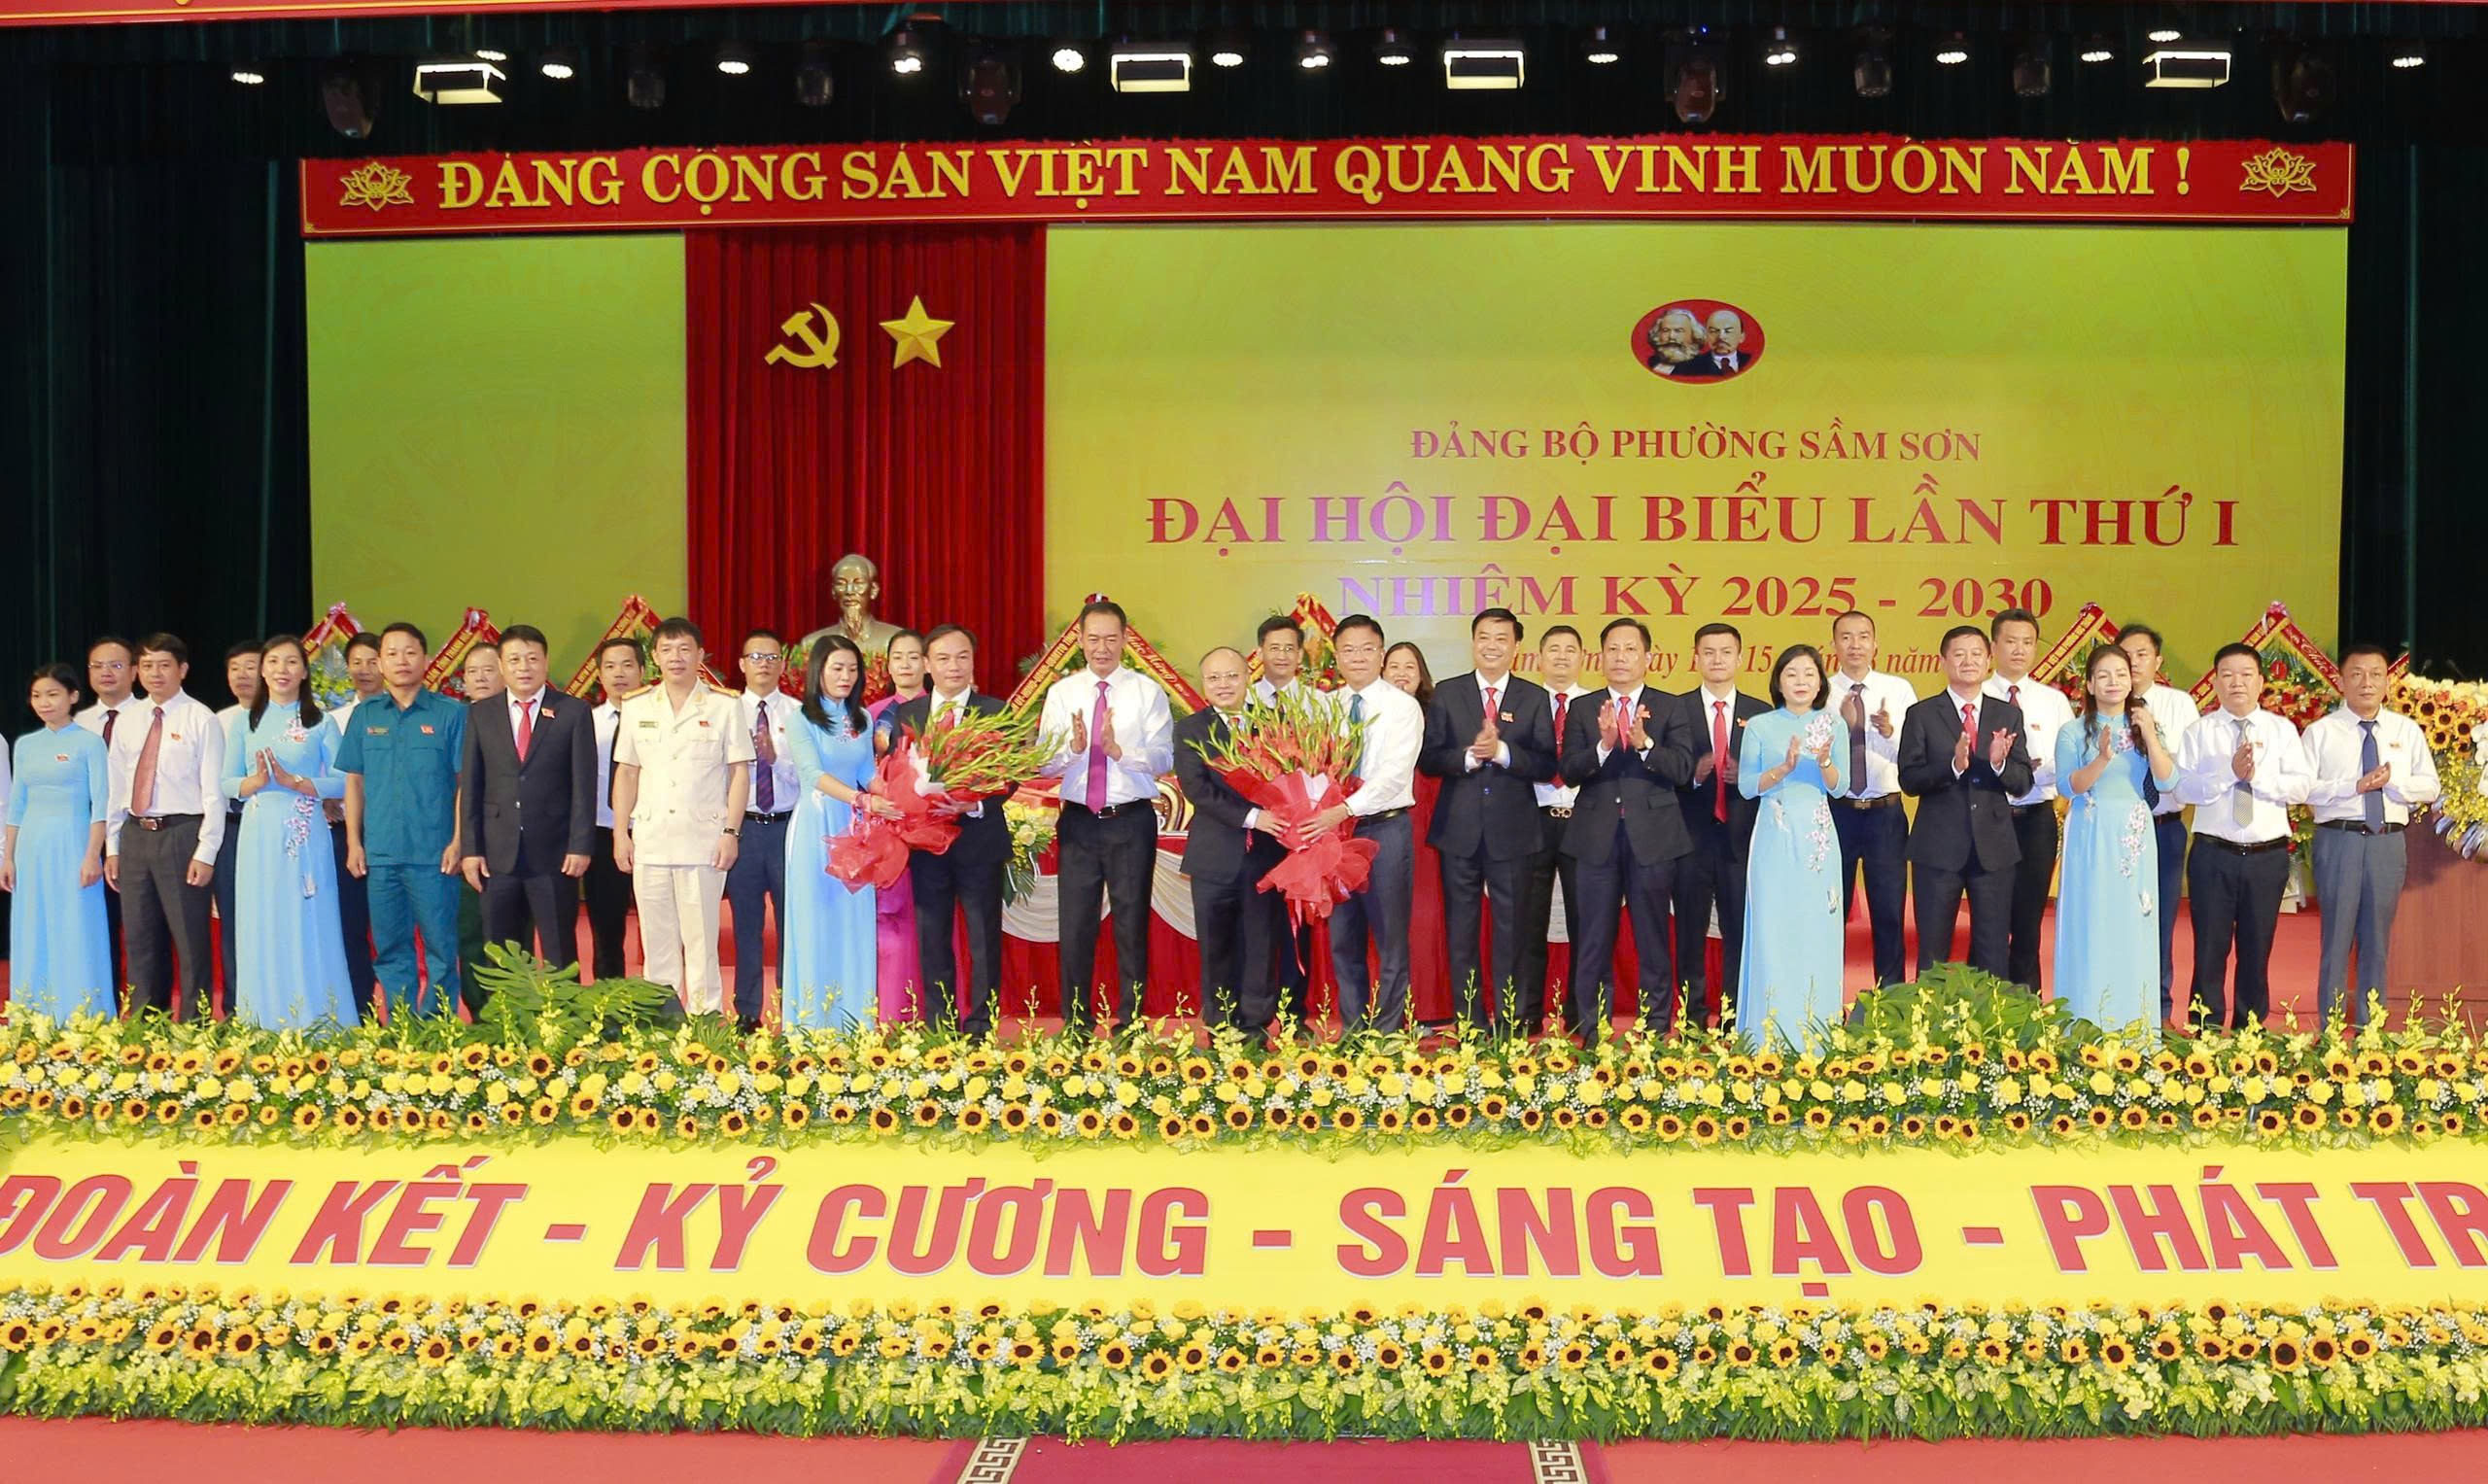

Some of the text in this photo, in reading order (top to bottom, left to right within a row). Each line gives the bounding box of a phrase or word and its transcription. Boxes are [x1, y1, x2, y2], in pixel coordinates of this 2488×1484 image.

[985, 139, 1149, 210] VIỆT
[1163, 146, 1318, 195] NAM
[1334, 143, 1574, 205] QUANG
[1585, 144, 1762, 193] VINH
[2176, 147, 2191, 195] !
[1410, 417, 1982, 466] ĐẢNG BỘ PHƯỜNG SẦM SƠN
[1146, 470, 2240, 558] ĐẠI HỘI ĐẠI BIỂU LẦN THỨ I
[1600, 562, 1703, 616] KỲ
[1720, 575, 1858, 617] 2025
[1878, 598, 1898, 607] -
[1917, 575, 2055, 620] 2030
[1886, 645, 1942, 673] năm
[0, 1160, 292, 1263] ĐOÀN
[290, 1156, 528, 1267] KẾT
[543, 1224, 587, 1242] -
[615, 1156, 783, 1271] KỶ
[806, 1177, 1209, 1277] CƯƠNG
[1252, 1229, 1293, 1248] -
[1336, 1169, 1663, 1278] SÁNG
[1693, 1185, 1922, 1297] TẠO
[1961, 1226, 2004, 1245] -
[2030, 1165, 2339, 1272] PHÁT
